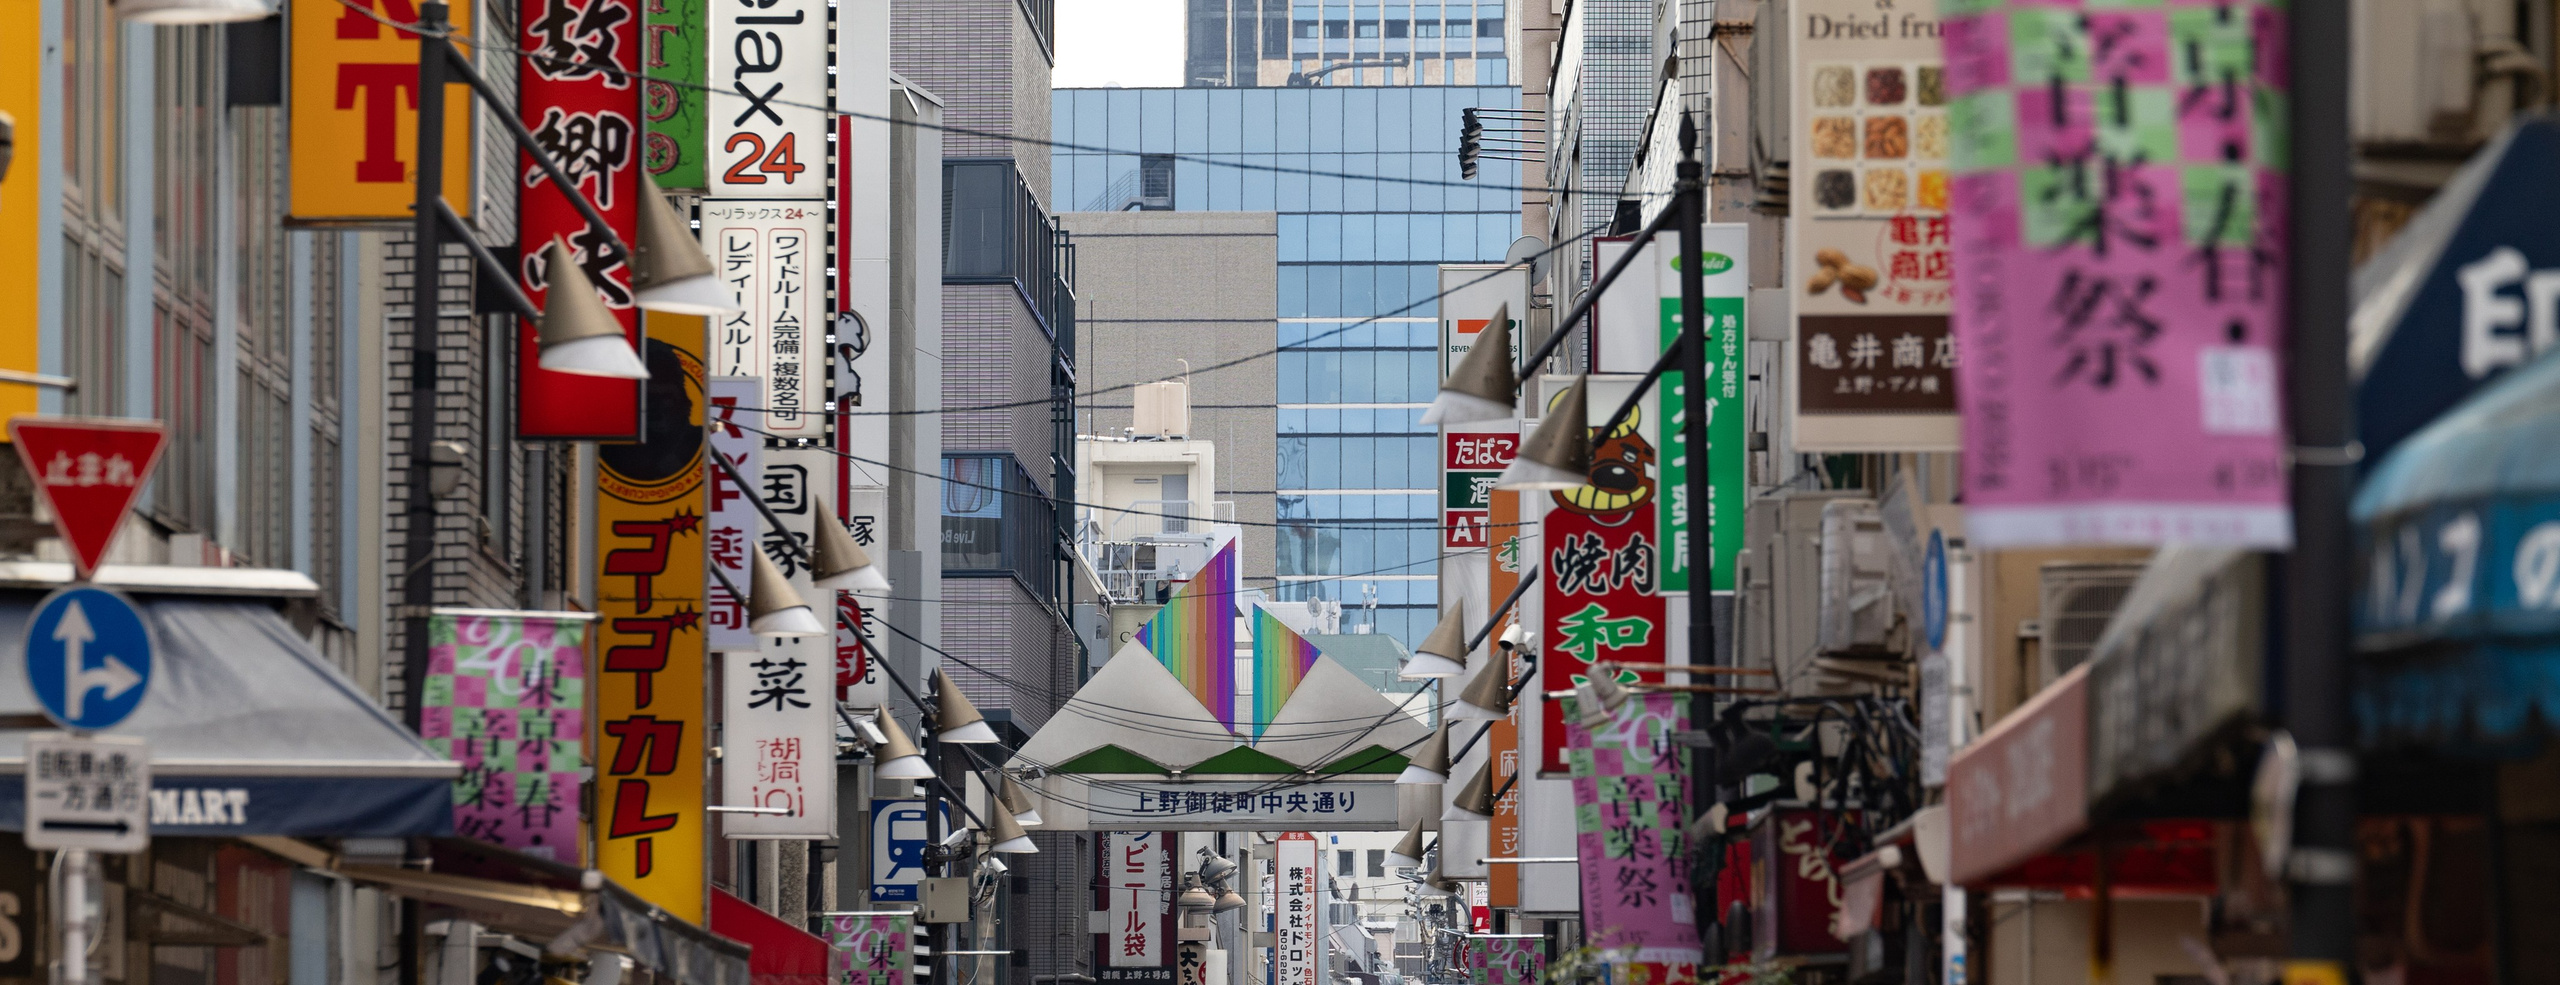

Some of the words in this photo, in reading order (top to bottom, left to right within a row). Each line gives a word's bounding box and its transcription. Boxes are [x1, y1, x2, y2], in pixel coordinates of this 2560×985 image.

[1807, 14, 1889, 40] Dried
[335, 0, 420, 183] T
[734, 0, 804, 127] lax
[722, 132, 805, 185] 24
[1721, 314, 1738, 399] 処方せん受付
[45, 450, 136, 488] 止まれ
[1455, 438, 1515, 466] たばこ
[1551, 531, 1657, 596] 焼肉
[1554, 602, 1654, 686] 和
[603, 505, 704, 879] ゴーゴーカレー
[755, 740, 770, 782] フートン
[769, 737, 801, 784] 胡同
[151, 788, 249, 825] MART
[1132, 790, 1355, 814] 上野御徒町中央通り
[1607, 775, 1658, 908] 音楽祭
[1124, 842, 1150, 957] ビニール袋
[1289, 866, 1304, 985] 株式会社ドロッ
